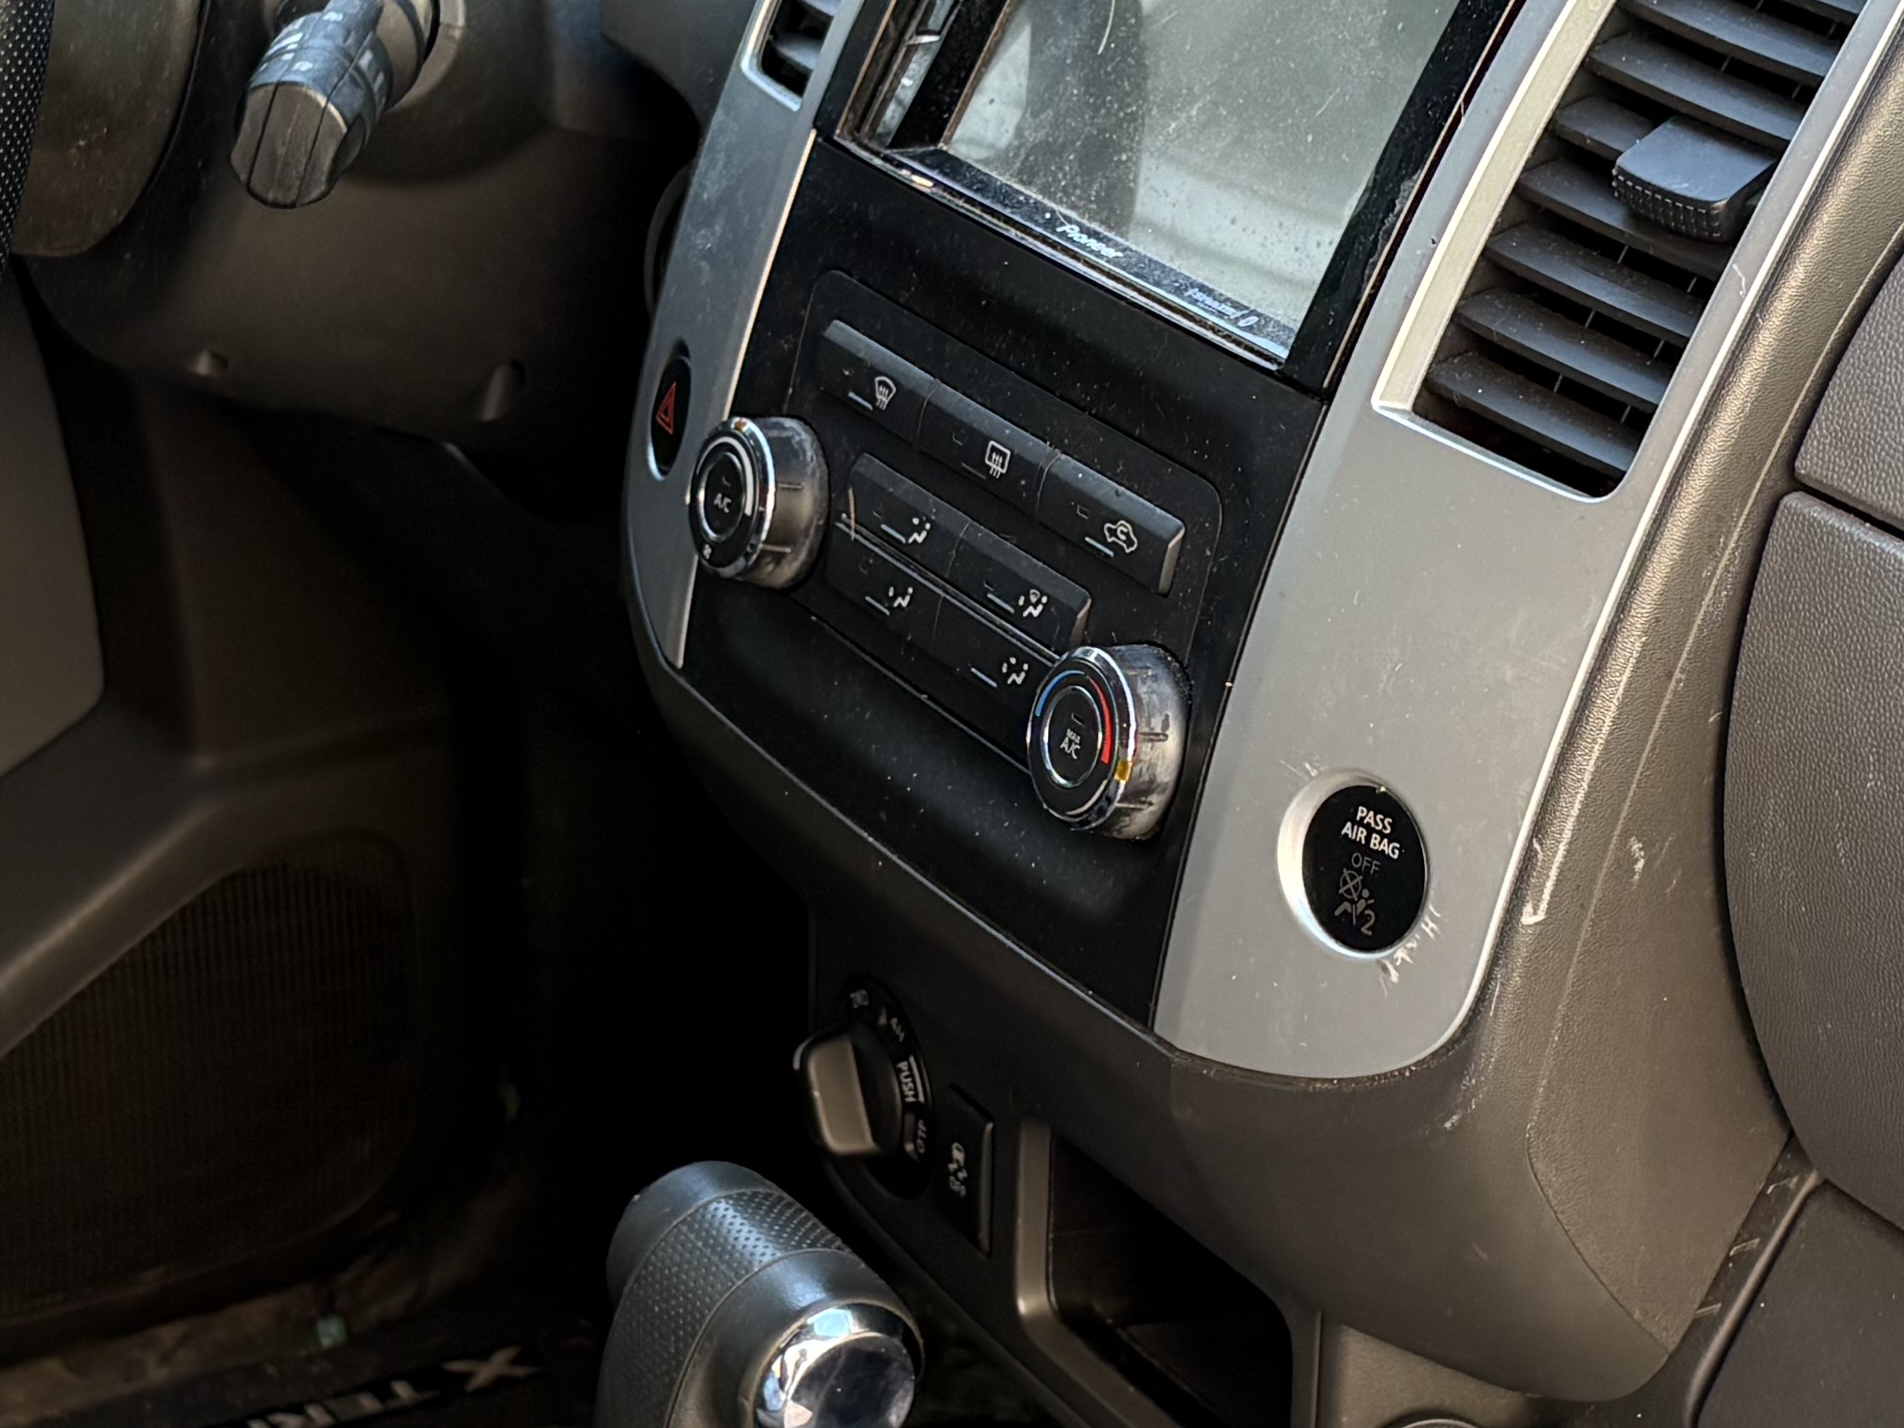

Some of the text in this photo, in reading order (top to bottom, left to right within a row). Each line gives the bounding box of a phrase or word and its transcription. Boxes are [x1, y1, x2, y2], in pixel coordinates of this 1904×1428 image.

[1055, 223, 1124, 260] Pioneer
[1059, 737, 1082, 760] A/C
[1356, 805, 1393, 835] PASS
[1341, 821, 1401, 860] AIR BAG
[1351, 852, 1381, 875] OFF
[897, 1060, 916, 1104] PUSH
